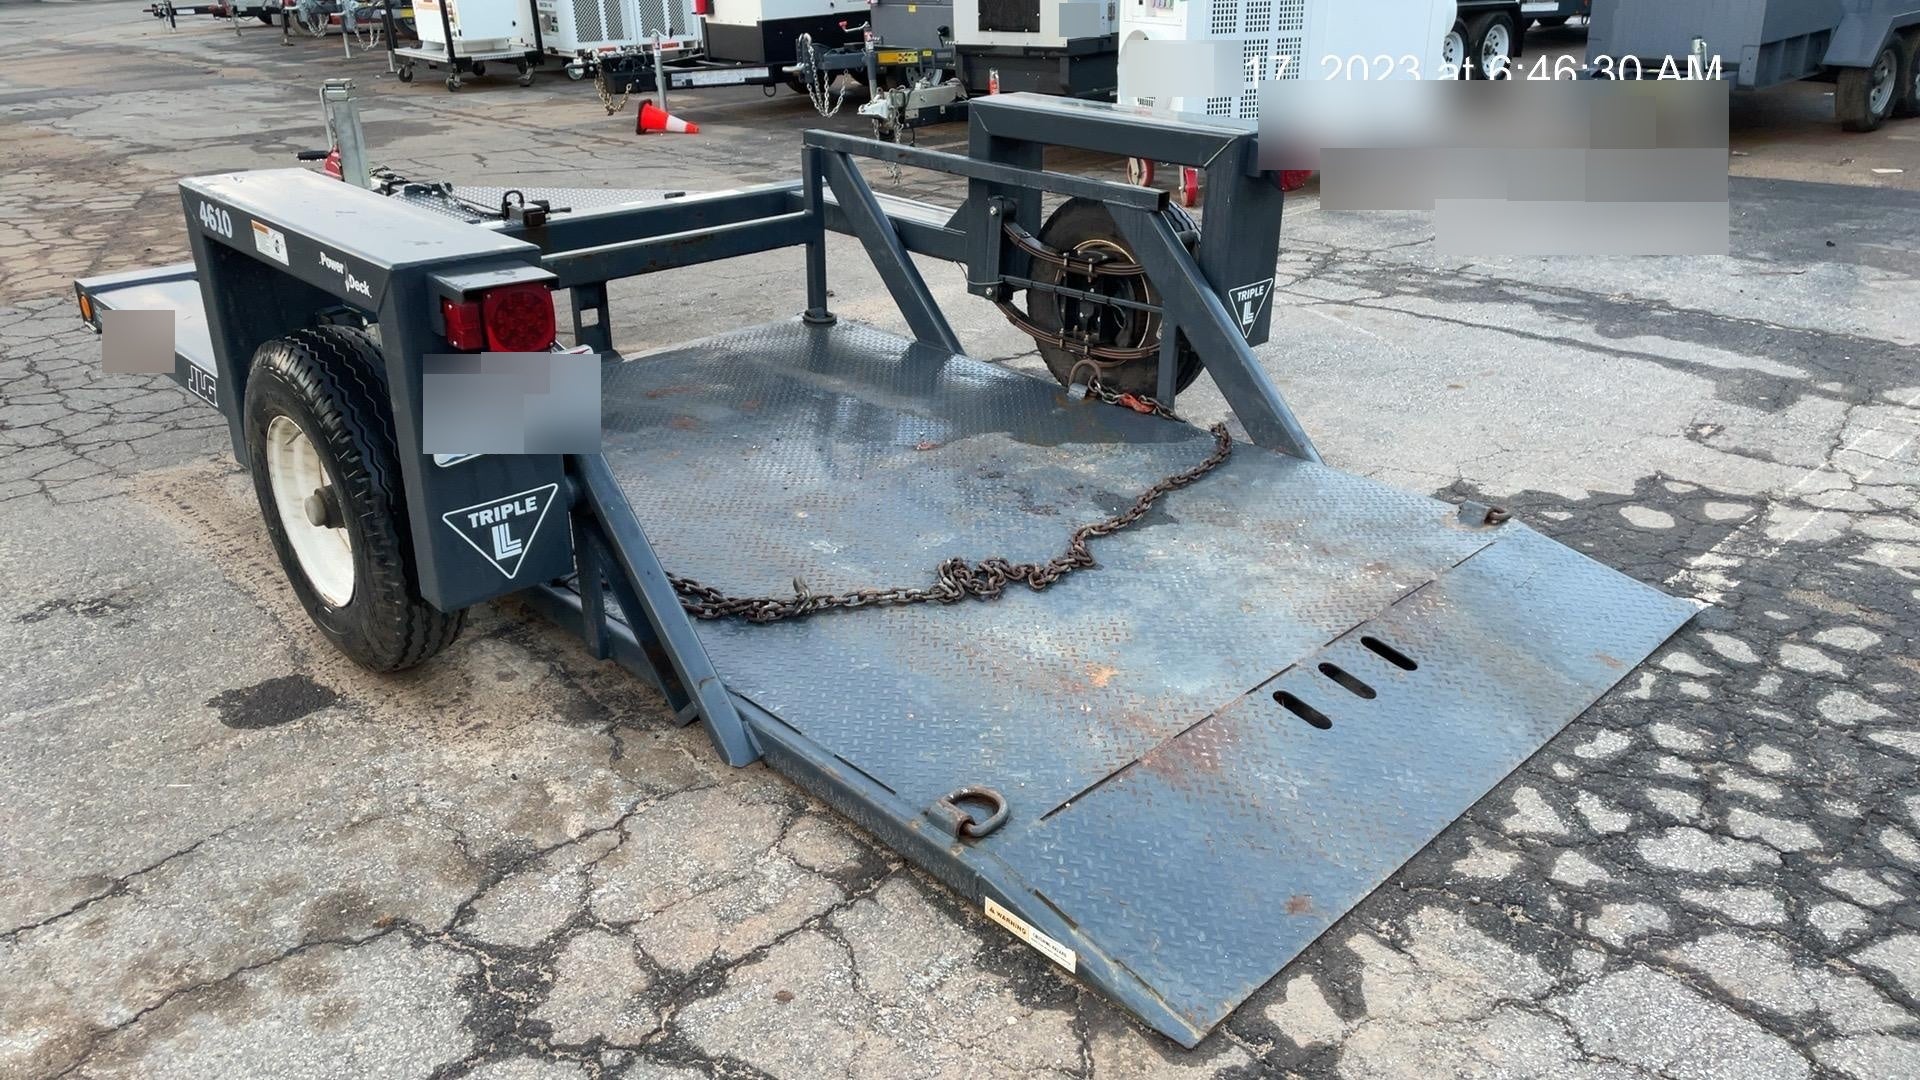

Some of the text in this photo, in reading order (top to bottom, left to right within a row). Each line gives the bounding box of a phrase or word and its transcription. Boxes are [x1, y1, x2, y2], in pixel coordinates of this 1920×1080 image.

[200, 201, 233, 239] 4610
[320, 251, 344, 275] Power
[1237, 285, 1265, 302] TRIPLE
[188, 364, 219, 408] JLG
[467, 496, 538, 529] TRIPLE
[996, 911, 1027, 935] WARNING
